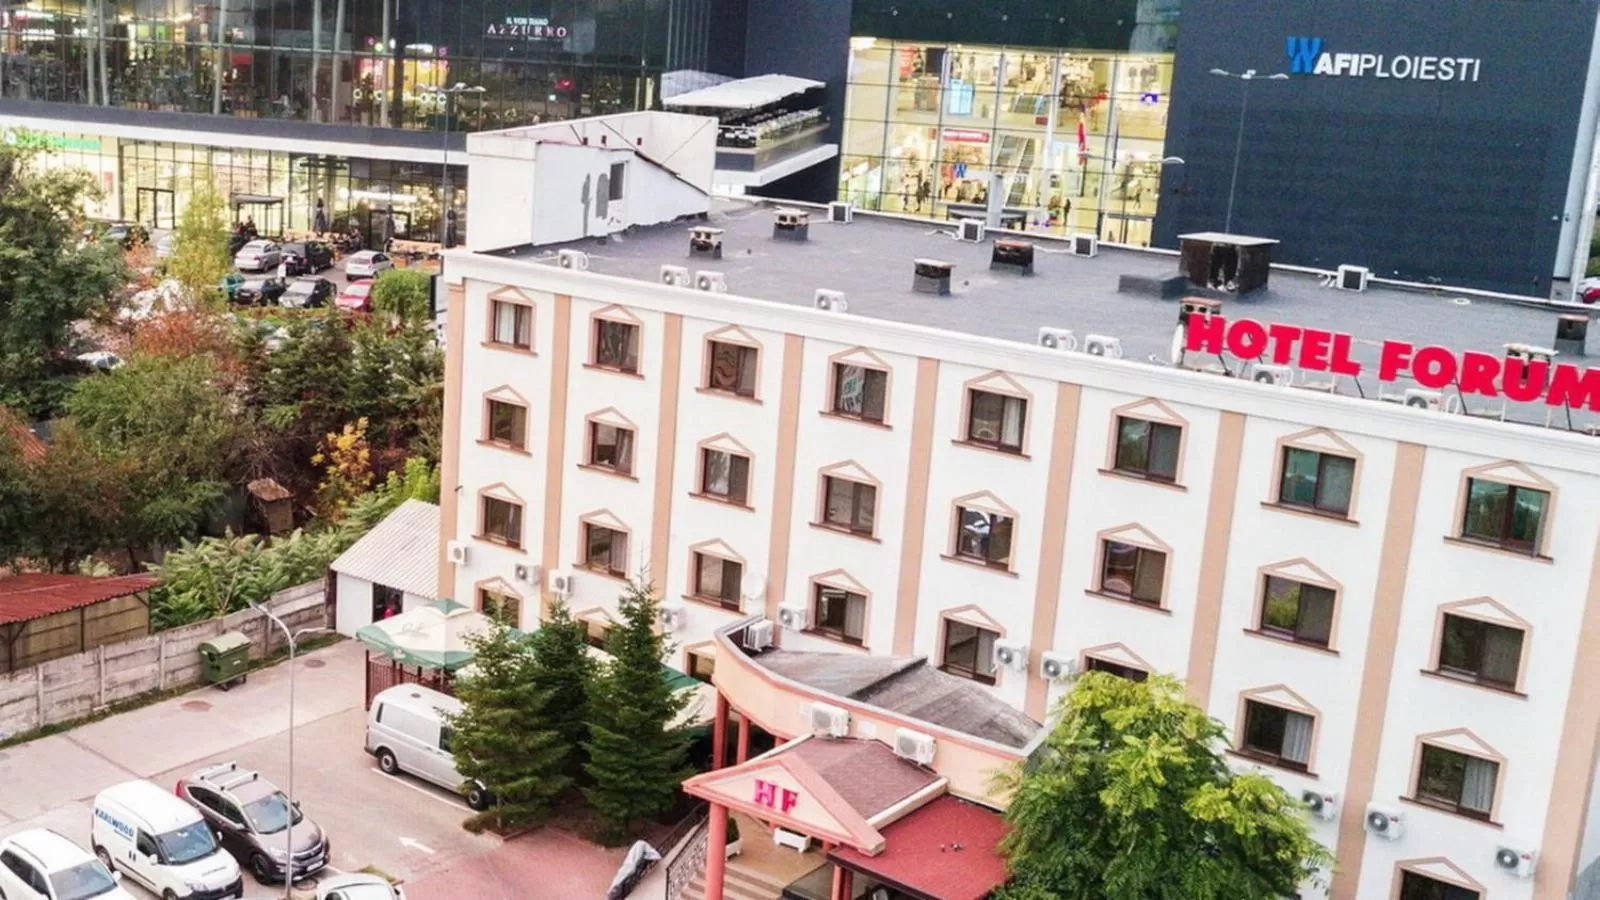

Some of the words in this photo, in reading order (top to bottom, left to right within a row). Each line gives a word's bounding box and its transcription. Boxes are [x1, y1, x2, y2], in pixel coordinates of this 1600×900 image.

[1186, 312, 1362, 377] HOTEL
[1378, 339, 1600, 415] FORUM
[754, 778, 798, 813] HF
